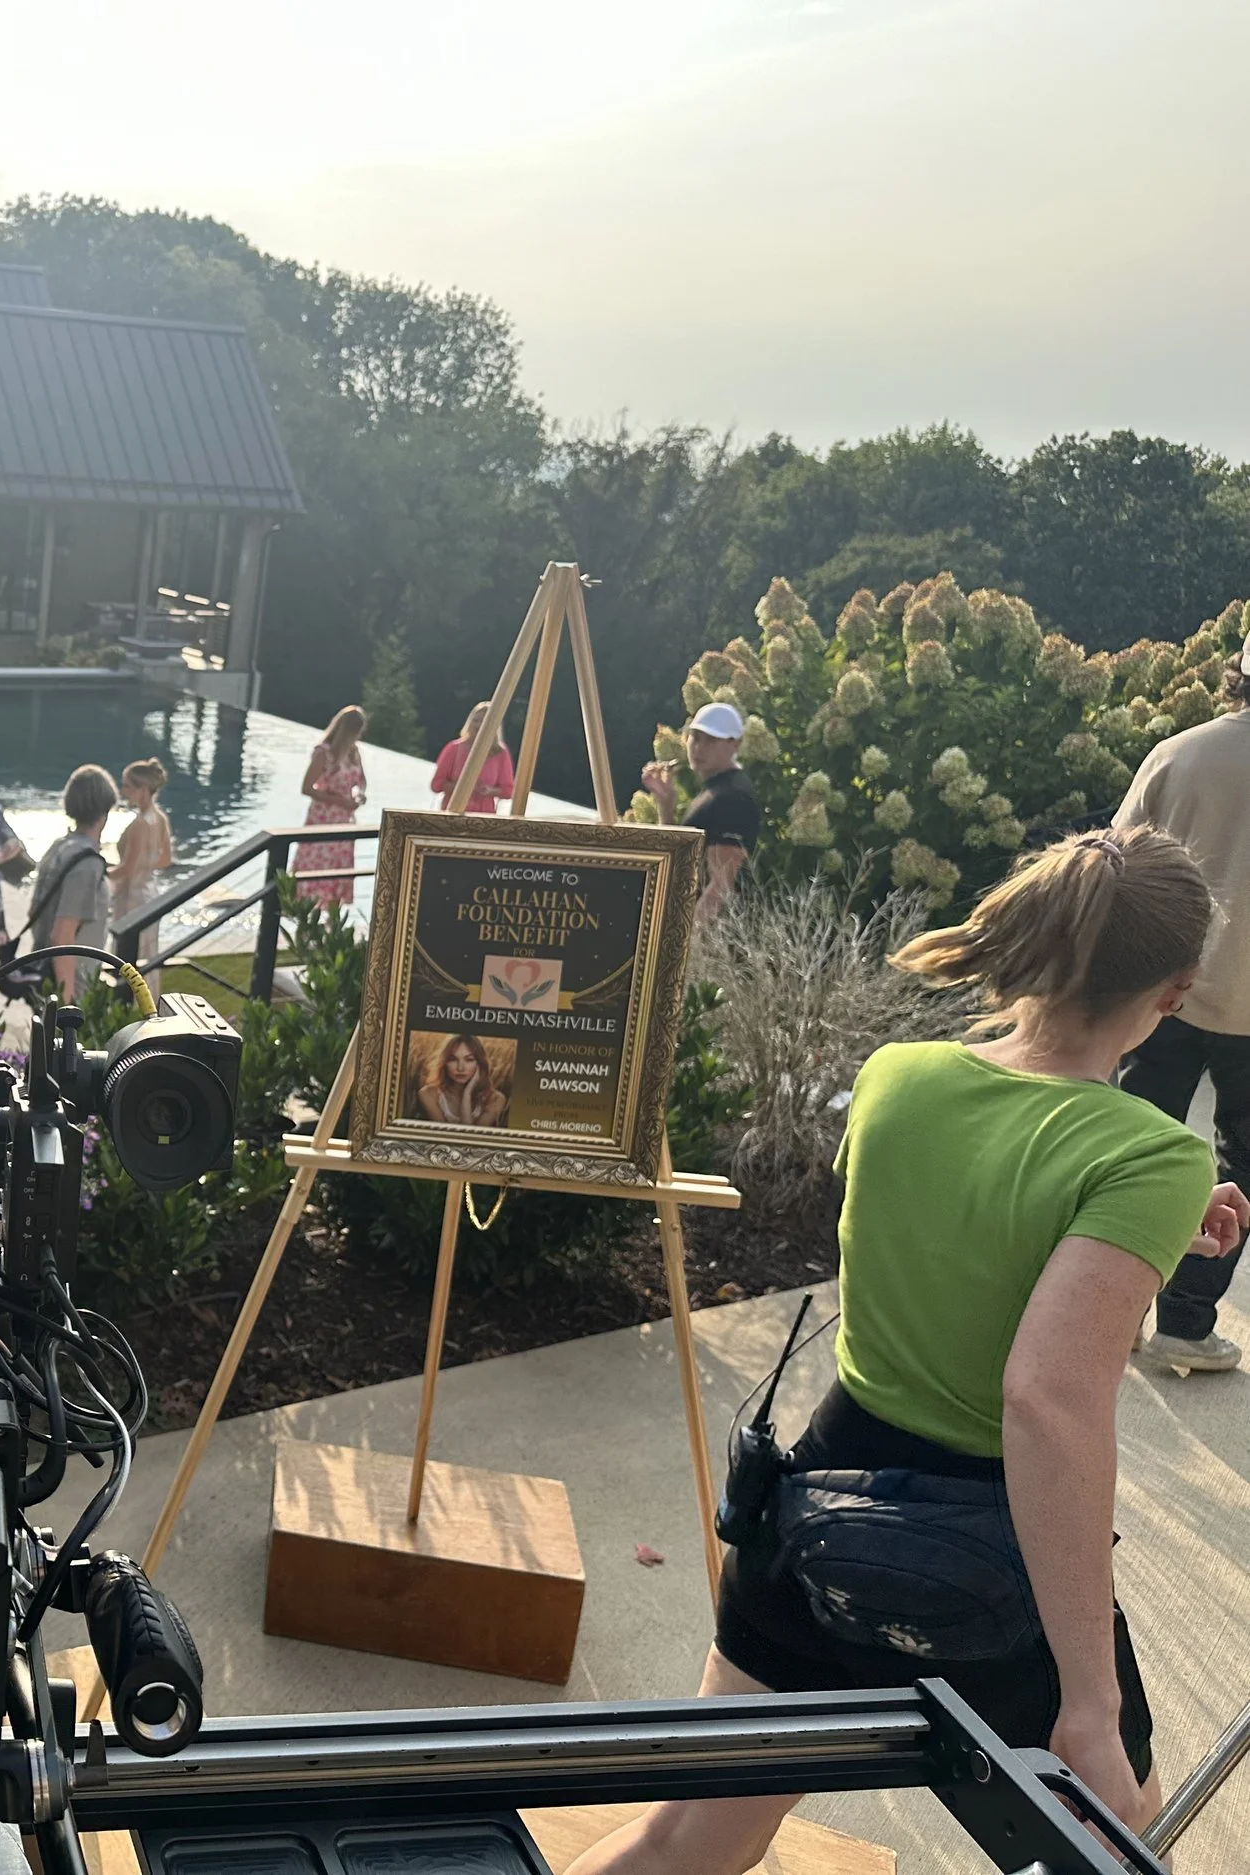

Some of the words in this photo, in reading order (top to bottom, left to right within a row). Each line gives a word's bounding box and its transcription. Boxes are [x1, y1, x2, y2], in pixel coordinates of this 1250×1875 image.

[487, 868, 554, 882] WELCOME
[561, 872, 579, 886] TO
[472, 886, 588, 911] CALLAHAN
[456, 903, 600, 930] FOUNDATION
[478, 923, 570, 947] BENEFIT
[512, 947, 536, 958] FOR
[425, 1004, 519, 1026] EMBOLDEN
[522, 1013, 617, 1033] NASHVILLE
[532, 1042, 546, 1053] IN
[549, 1043, 595, 1057] HONOR
[598, 1046, 615, 1058] OF
[535, 1060, 609, 1076] SAVANNAH
[539, 1078, 600, 1094] DAWSON
[530, 1119, 557, 1130] CHRIS
[559, 1121, 602, 1133] MORENO
